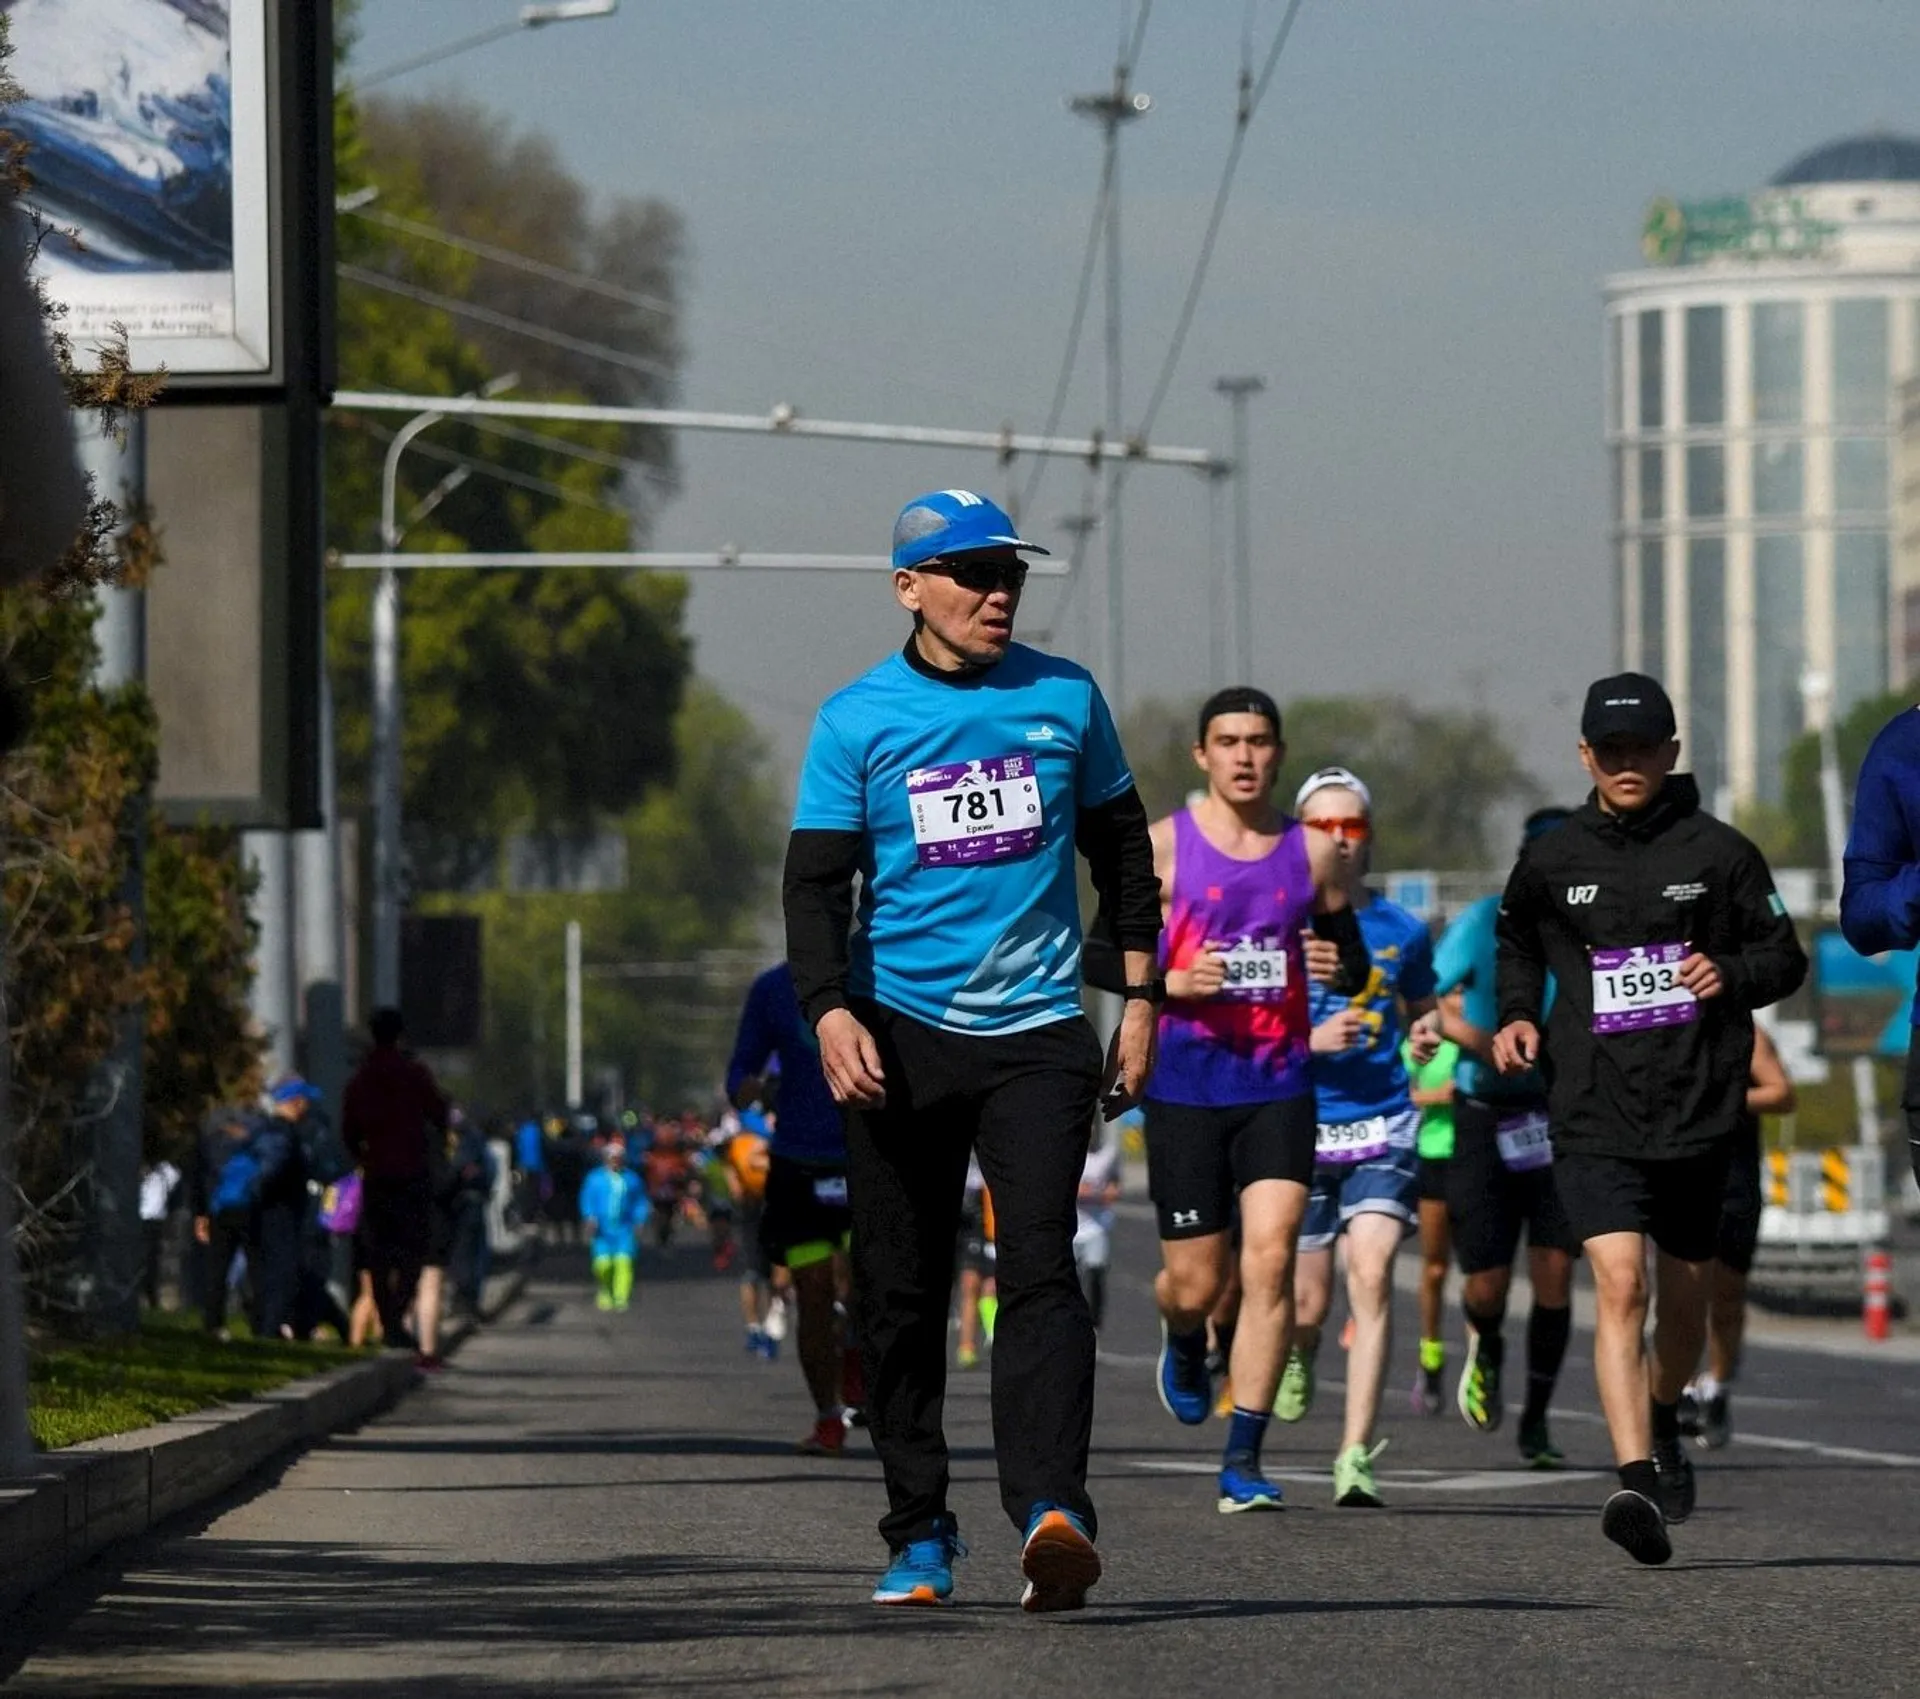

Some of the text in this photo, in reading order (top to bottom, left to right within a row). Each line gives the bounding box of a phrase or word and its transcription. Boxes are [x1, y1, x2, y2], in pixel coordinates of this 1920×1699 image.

[943, 788, 1004, 823] 781
[1566, 884, 1600, 905] UR7
[1605, 969, 1673, 999] 1593
